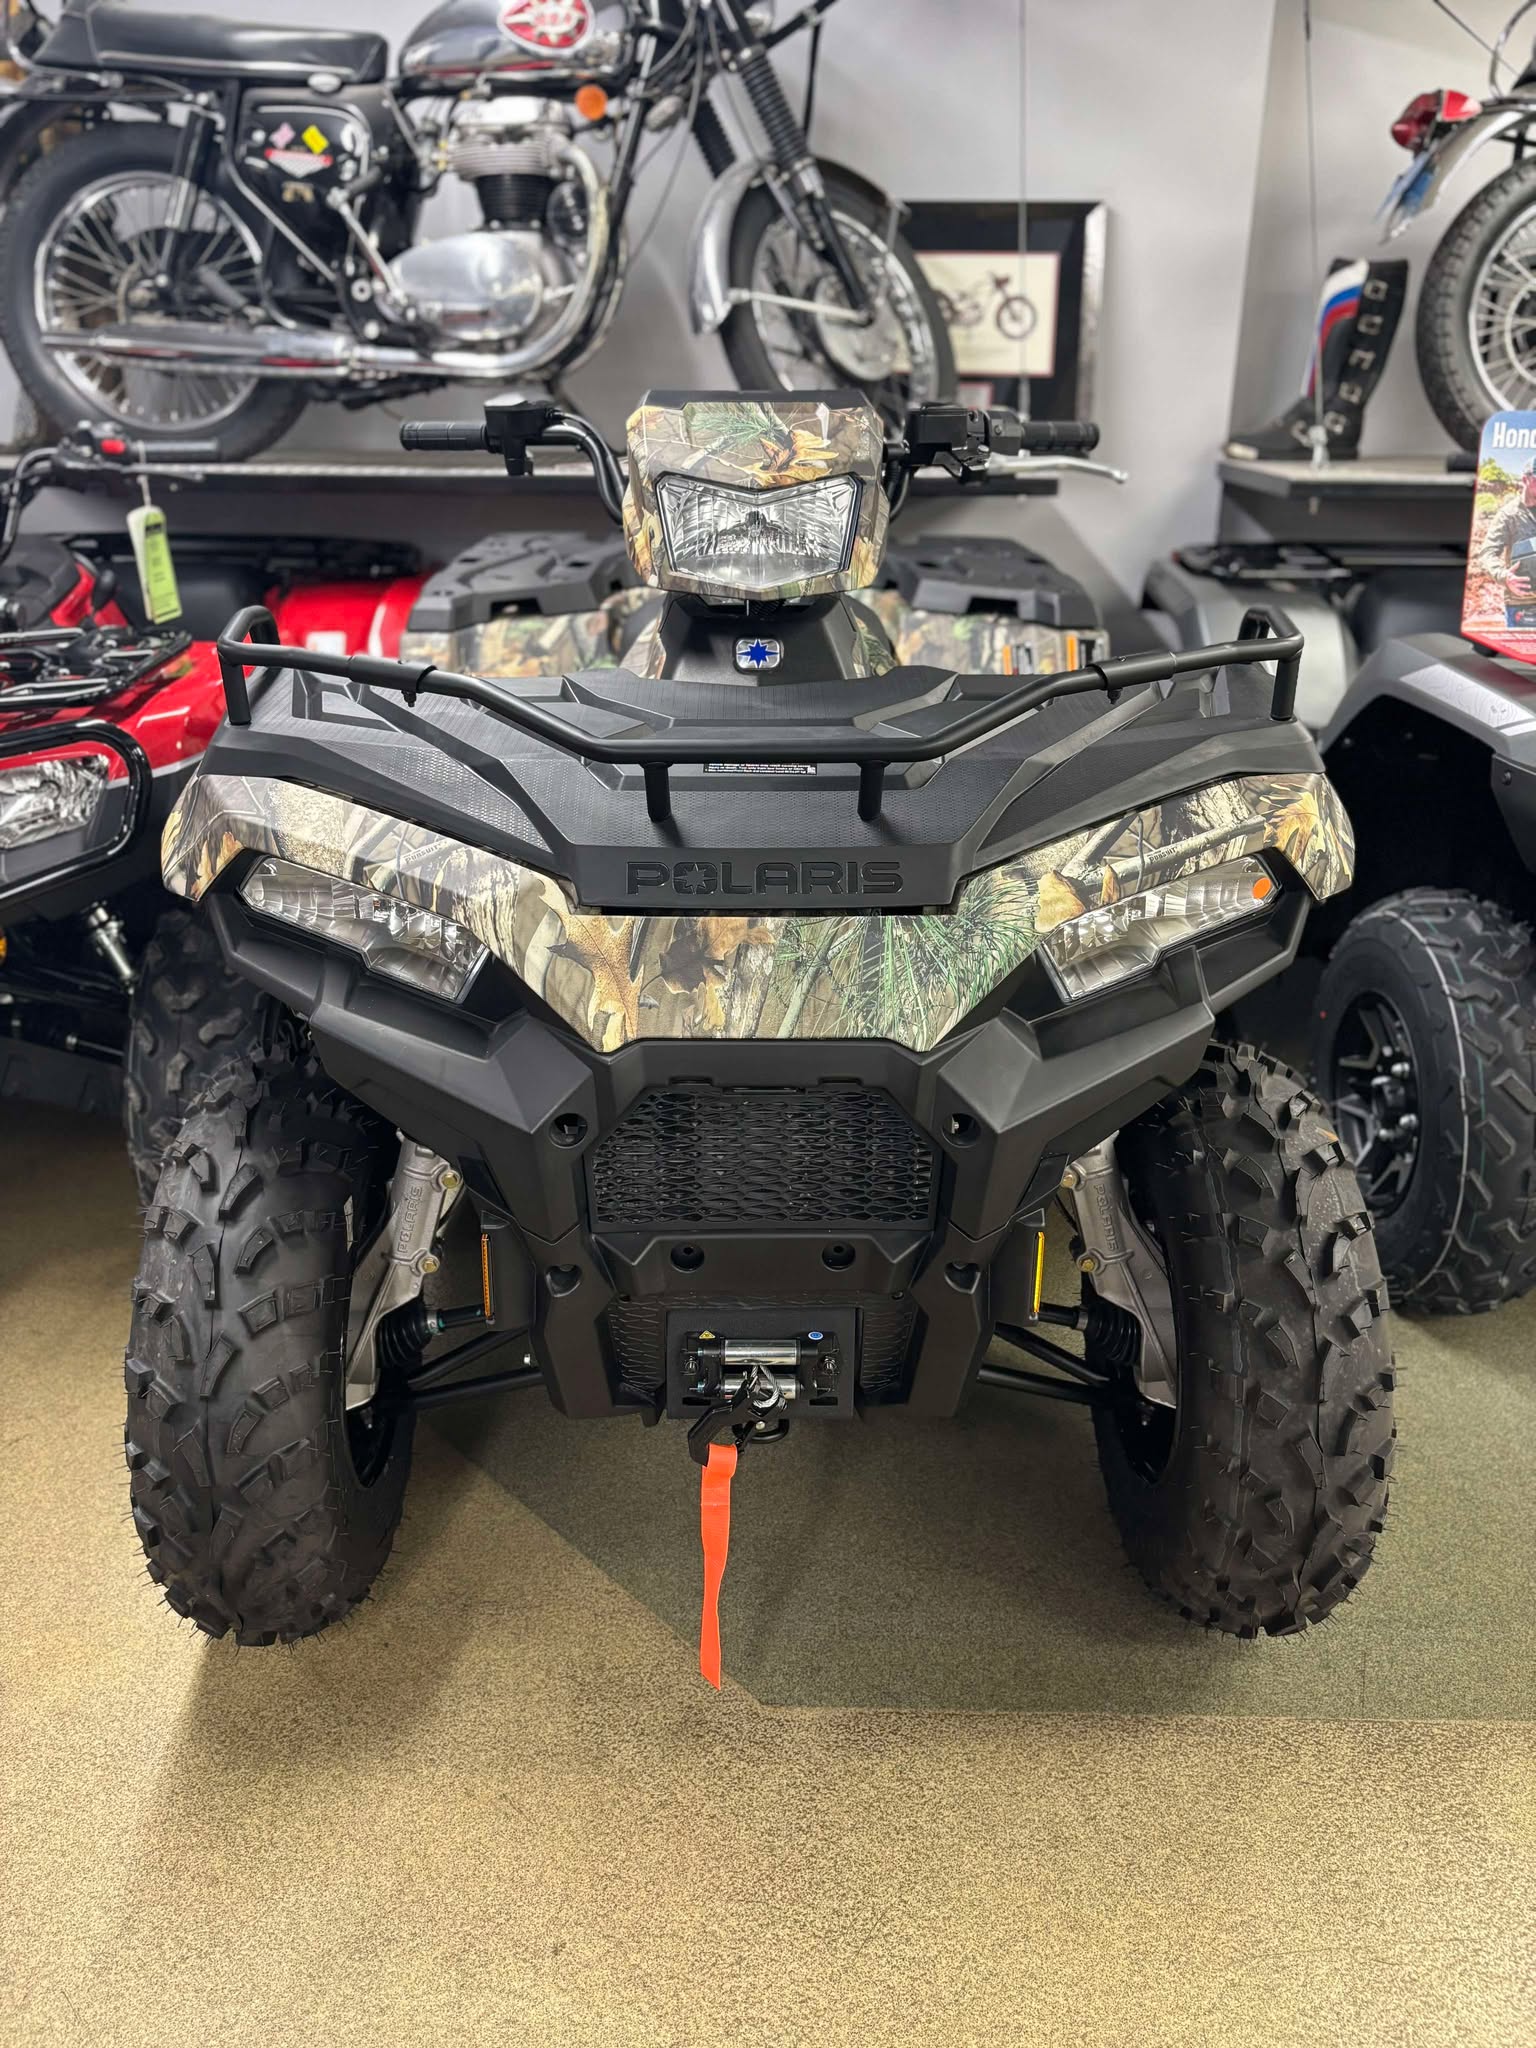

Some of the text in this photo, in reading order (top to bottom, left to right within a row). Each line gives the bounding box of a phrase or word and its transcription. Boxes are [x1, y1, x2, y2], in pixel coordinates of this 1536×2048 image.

[626, 861, 904, 895] POLARIS
[397, 1186, 423, 1254] POLARIS
[1094, 1183, 1119, 1251] POLARIS
